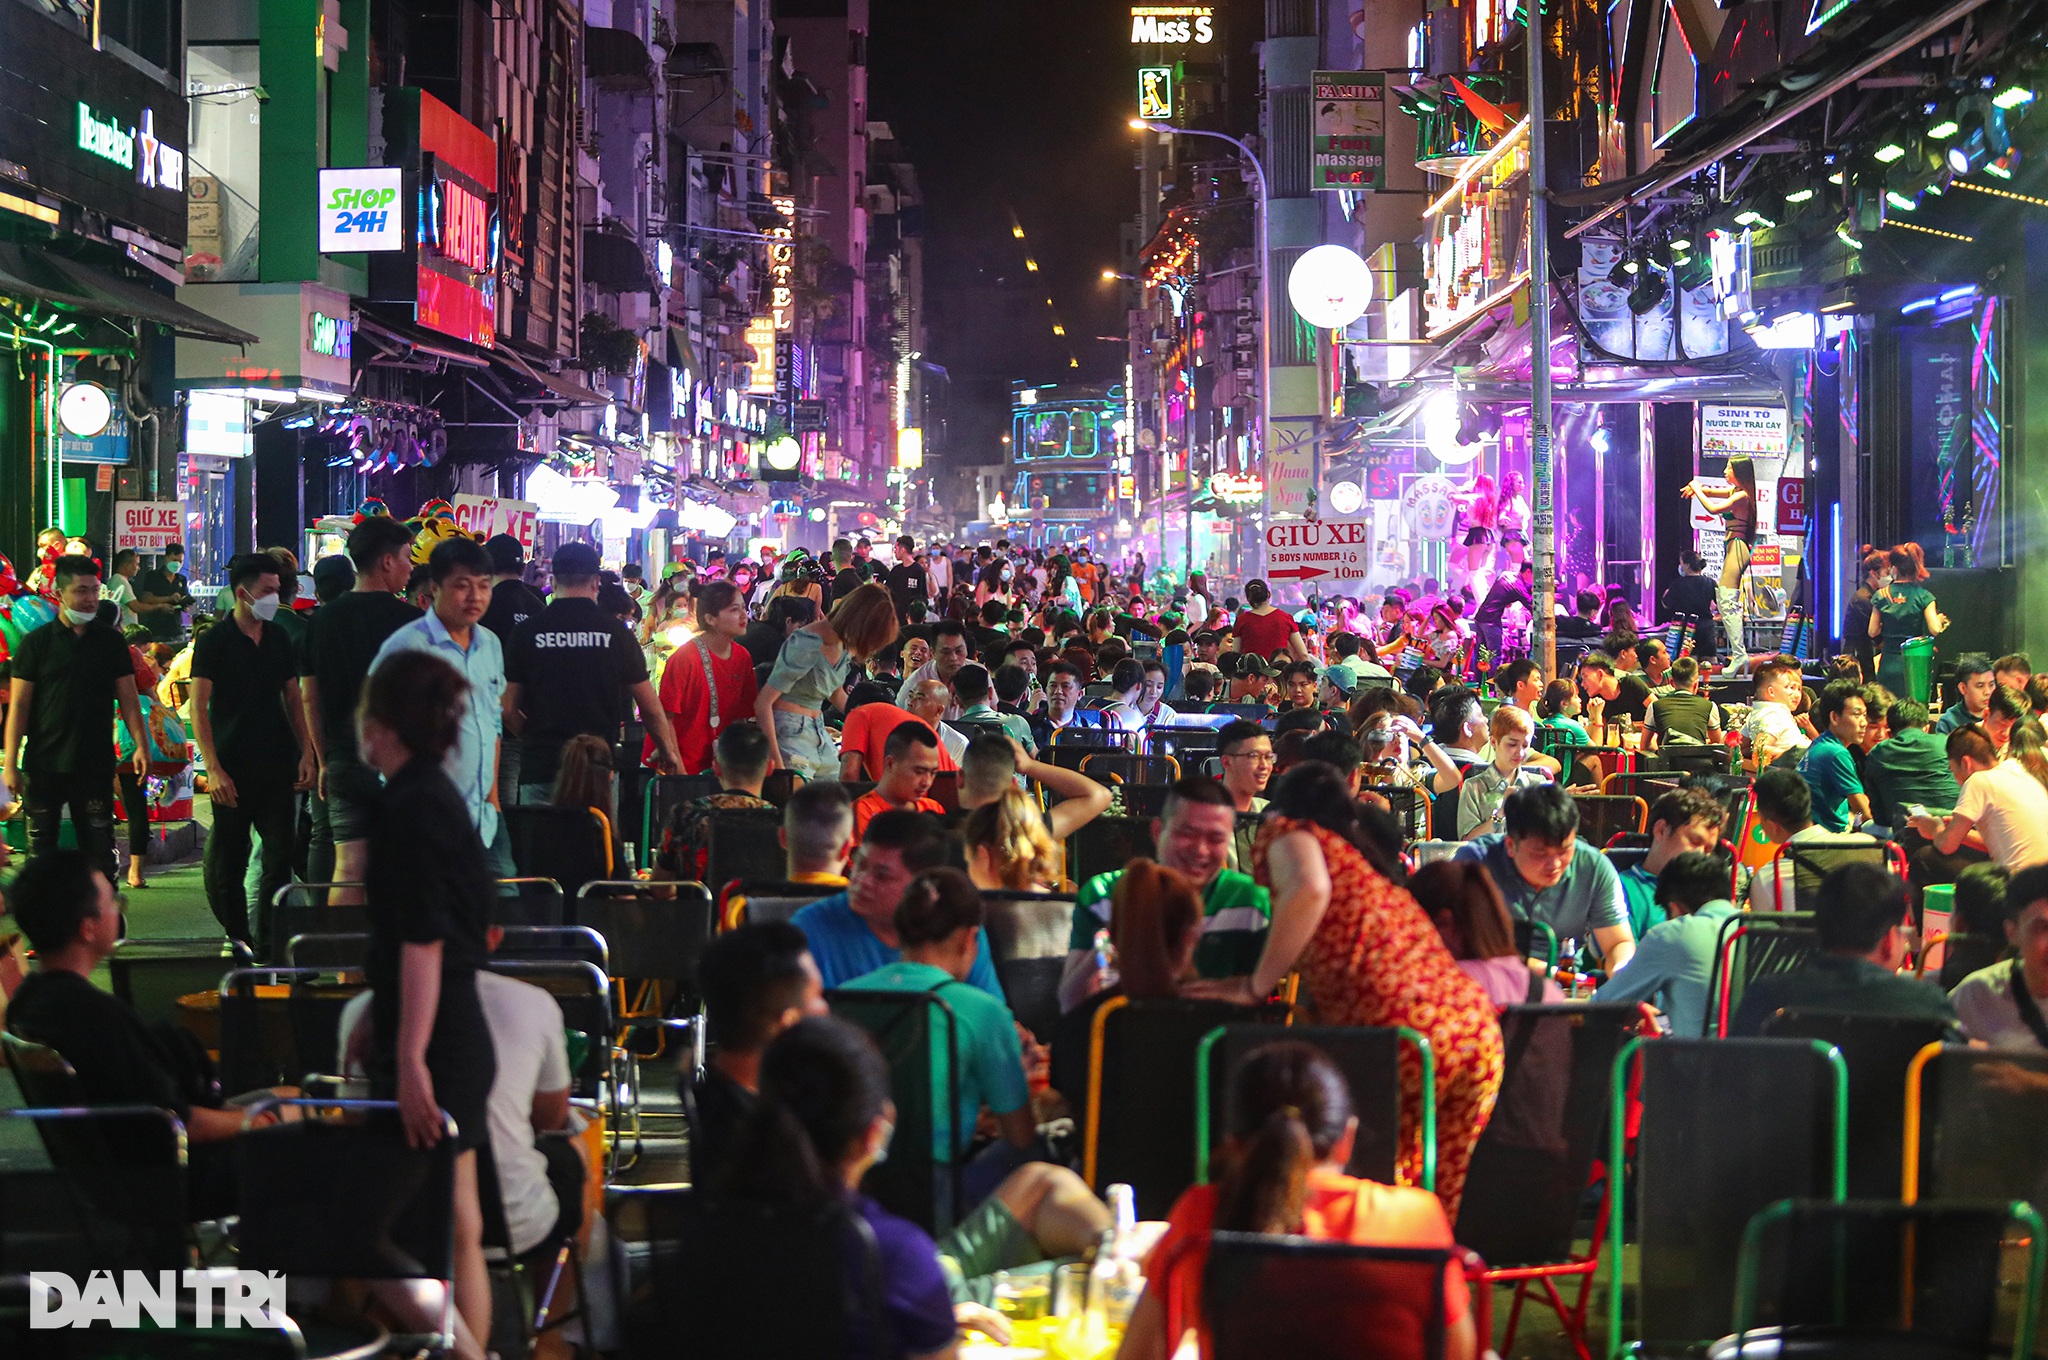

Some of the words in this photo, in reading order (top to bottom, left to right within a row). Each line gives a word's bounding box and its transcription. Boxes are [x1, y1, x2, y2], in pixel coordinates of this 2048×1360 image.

[1194, 16, 1213, 43] S
[1316, 85, 1381, 99] FAMILY
[79, 101, 133, 170] Heineken
[1316, 154, 1382, 167] Massage
[327, 188, 396, 209] SHOP
[335, 211, 388, 233] 24H
[312, 312, 335, 355] SHOP
[334, 318, 351, 358] 24H
[1718, 409, 1750, 418] SINH
[1370, 467, 1395, 497] 9
[1276, 486, 1303, 506] Spa
[126, 506, 154, 527] GIỮ
[158, 509, 177, 527] XE
[505, 509, 536, 547] XE
[1327, 523, 1366, 545] XE
[139, 535, 147, 547] 57
[1272, 553, 1277, 562] 5
[1280, 553, 1300, 562] BOYS
[1303, 552, 1340, 562] NUMBER
[1334, 566, 1364, 579] 10m
[535, 631, 612, 648] SECURITY
[1759, 829, 1765, 842] 1
